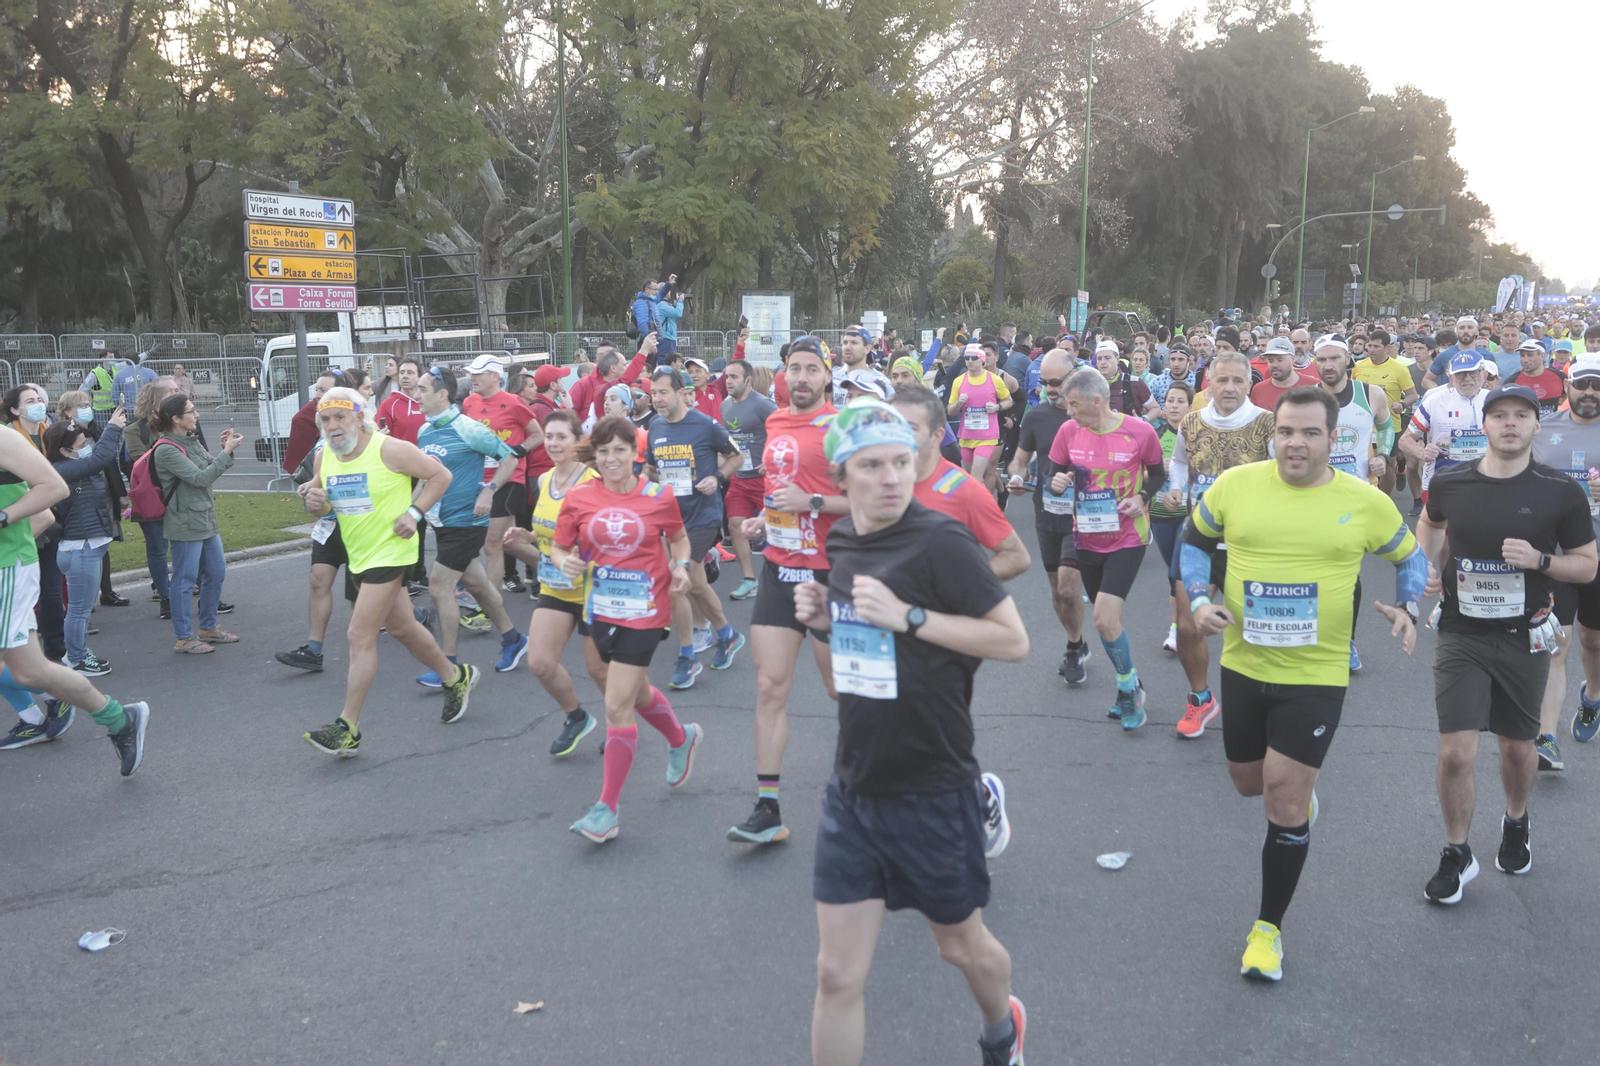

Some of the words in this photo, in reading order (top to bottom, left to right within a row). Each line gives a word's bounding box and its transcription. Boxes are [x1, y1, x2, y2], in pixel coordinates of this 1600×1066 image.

[250, 194, 279, 204] hospital
[250, 204, 279, 216] Virgen
[282, 208, 296, 216] del
[300, 208, 322, 218] Rocío
[252, 228, 282, 236] estación
[285, 228, 309, 238] Prado
[252, 237, 269, 246] San
[274, 238, 316, 248] Sebastián
[284, 268, 306, 278] Plaza
[326, 270, 352, 279] Armas
[299, 288, 324, 298] Caixa
[328, 289, 353, 298] Forum
[298, 299, 320, 307] Torre
[325, 300, 353, 308] Sevilla
[655, 444, 693, 455] MARATONA
[1475, 562, 1515, 571] ZURICH
[609, 571, 641, 580] ZURICH
[778, 566, 814, 583] 226ERS
[1476, 581, 1500, 590] 9455
[607, 587, 630, 596] 10225
[1266, 586, 1309, 596] ZURICH
[1264, 607, 1295, 616] 10809
[1248, 620, 1272, 630] FELIPE
[1276, 623, 1313, 631] ESCOLAR
